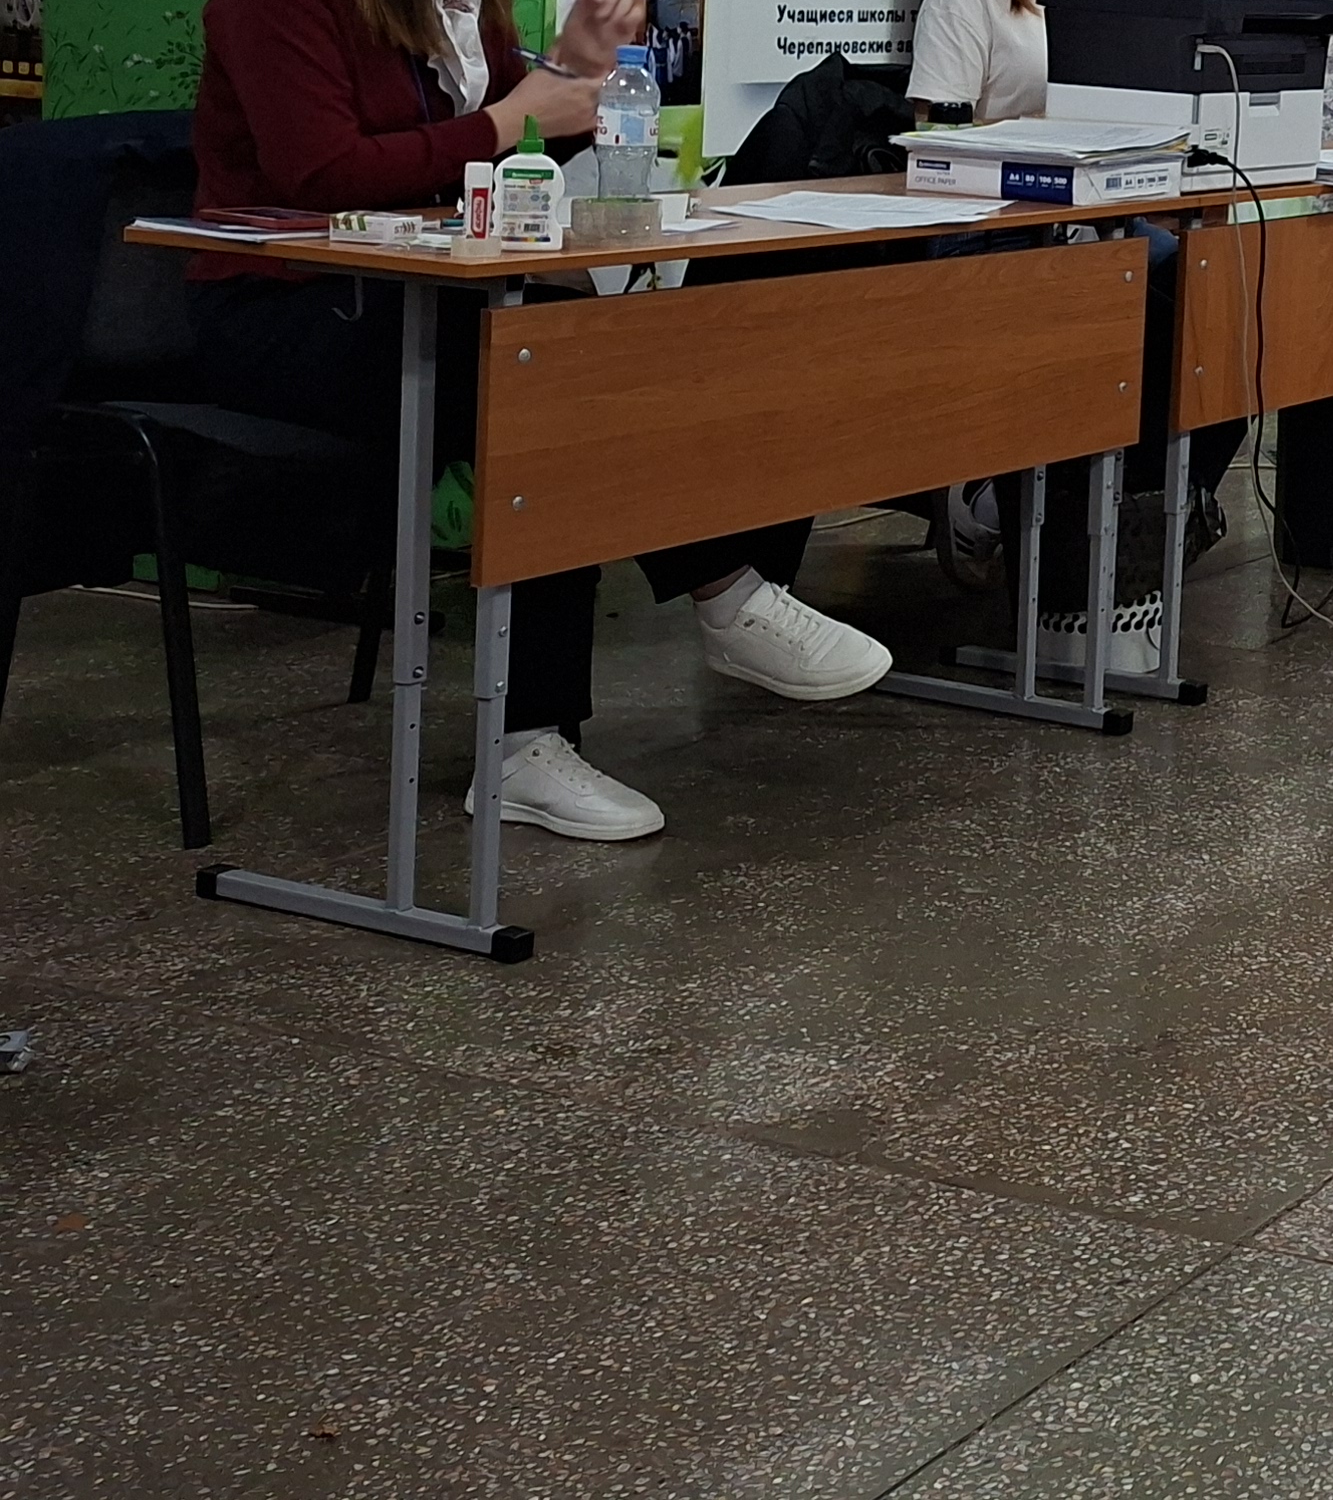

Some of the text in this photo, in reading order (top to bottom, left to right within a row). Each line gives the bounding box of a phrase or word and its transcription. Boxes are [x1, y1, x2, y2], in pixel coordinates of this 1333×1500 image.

[777, 4, 854, 26] Учащиеся
[858, 9, 906, 23] школы
[777, 37, 892, 60] Черепановские
[914, 175, 957, 186] OFFICE PAPER
[1008, 172, 1020, 182] A4
